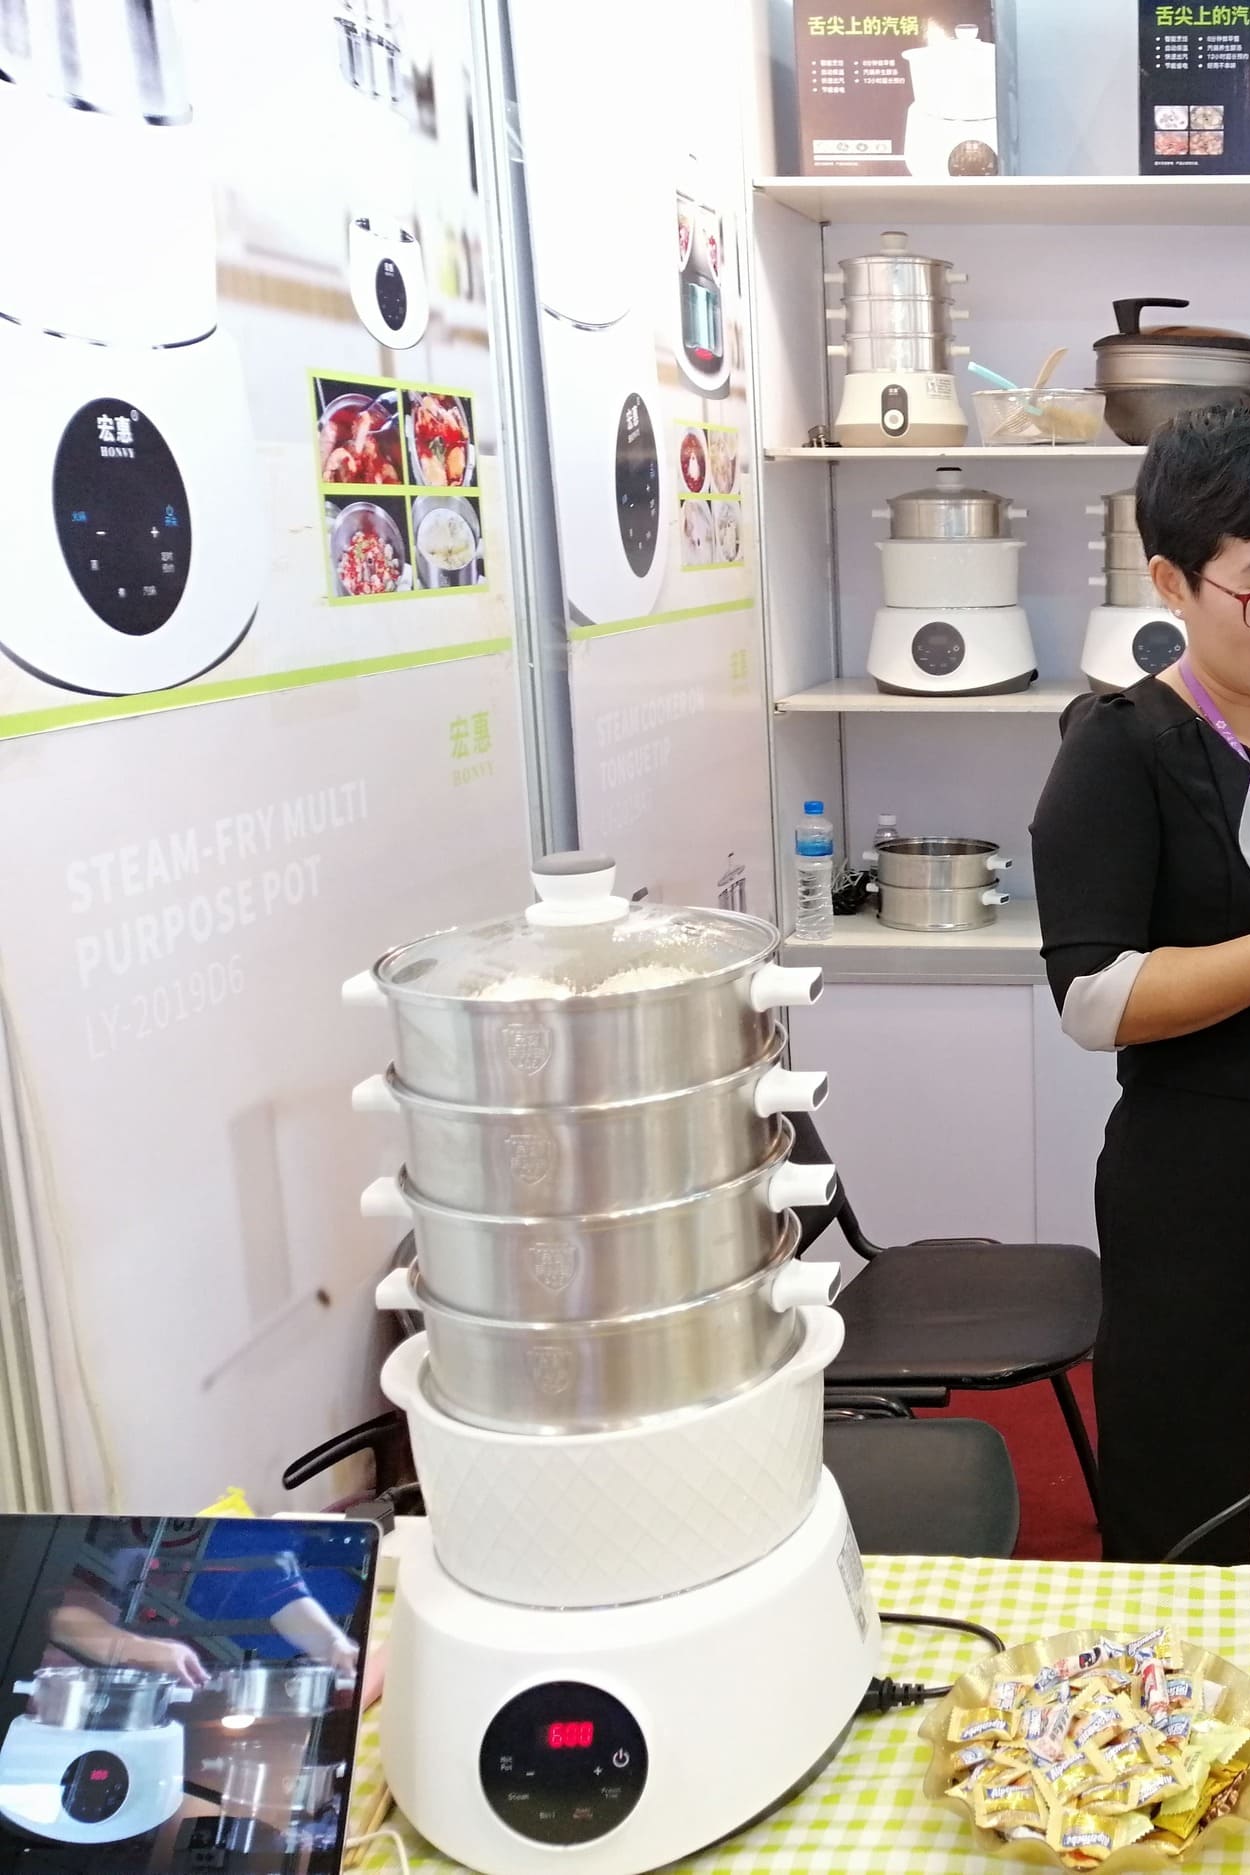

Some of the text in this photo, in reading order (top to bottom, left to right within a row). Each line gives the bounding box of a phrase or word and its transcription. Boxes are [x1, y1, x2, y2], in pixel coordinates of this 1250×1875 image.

[808, 16, 919, 36] 舌尖上的汽锅
[97, 414, 133, 443] 宏惠
[449, 710, 492, 758] 宏惠
[66, 779, 368, 914] STEAM-FRY MULTI
[75, 853, 321, 989] PURPOSE POT
[86, 954, 244, 1061] LY-2019D6
